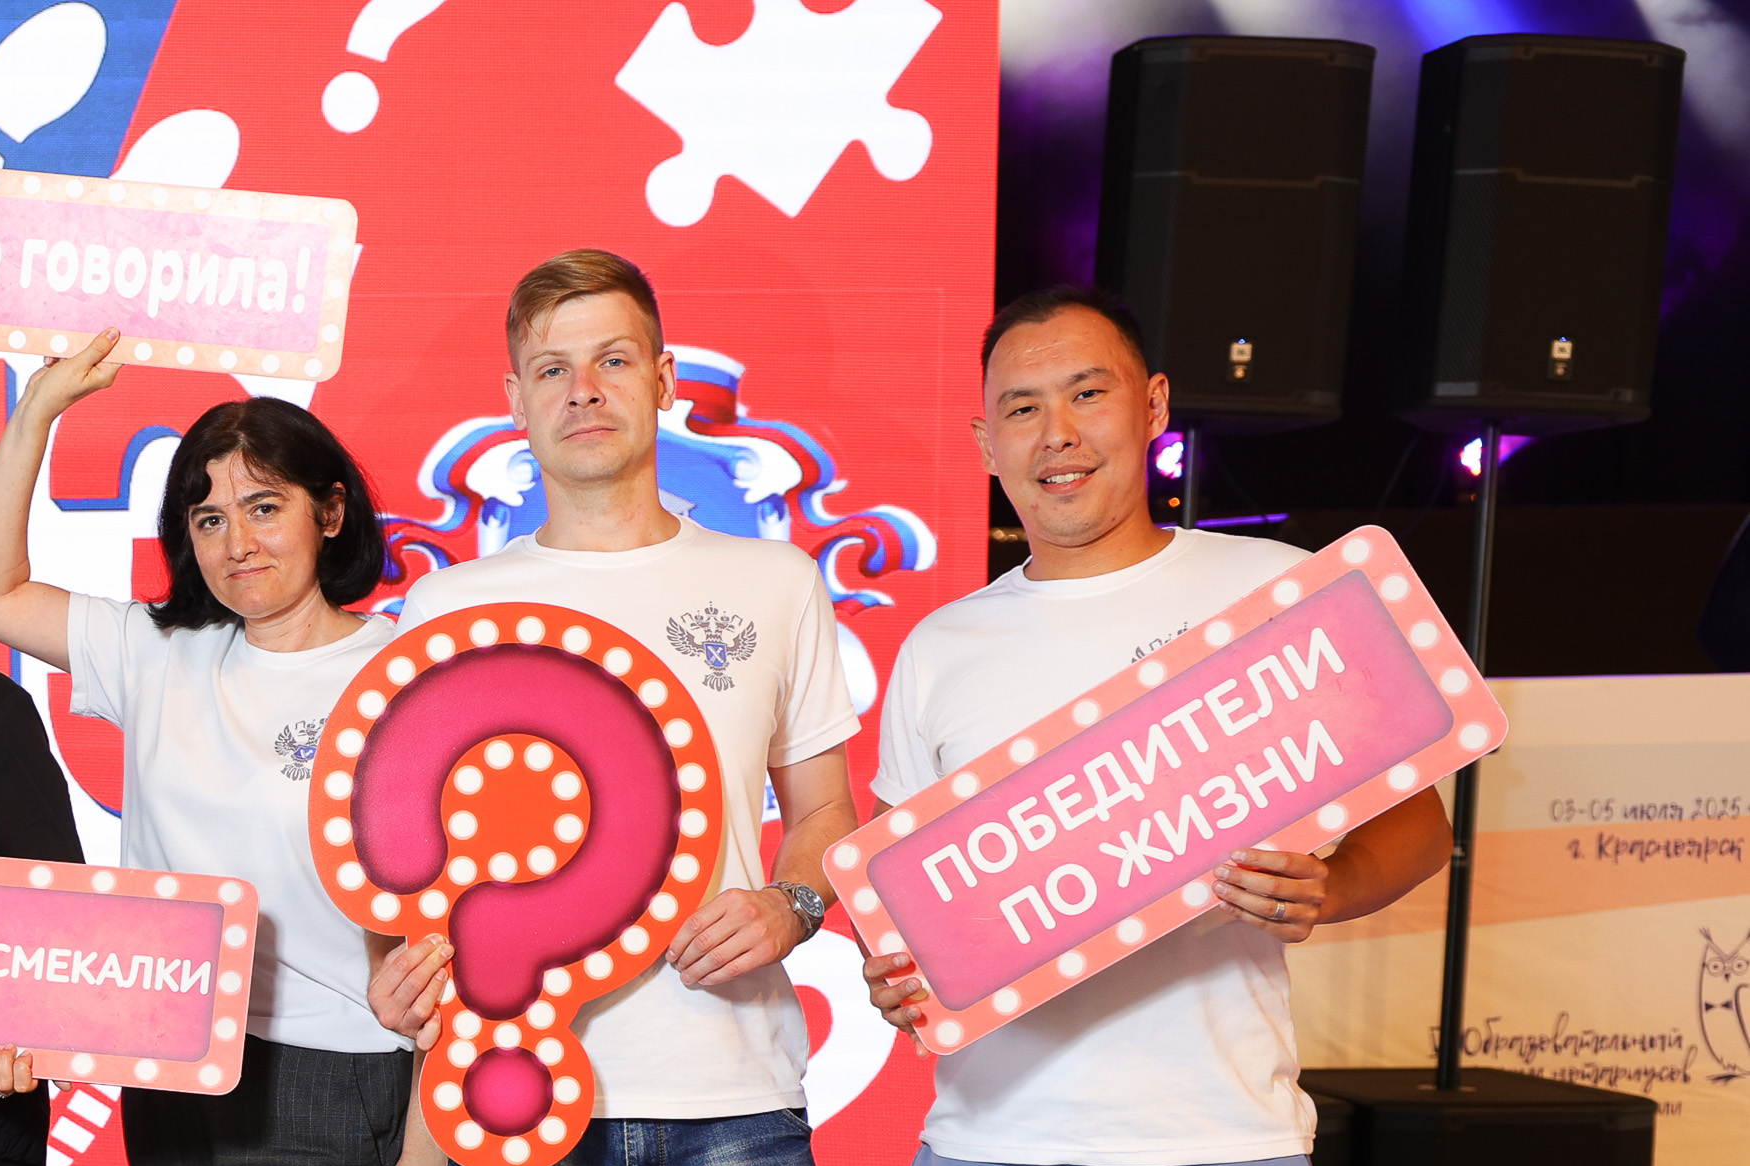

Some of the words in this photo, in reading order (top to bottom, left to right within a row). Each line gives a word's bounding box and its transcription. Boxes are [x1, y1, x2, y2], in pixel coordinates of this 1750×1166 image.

[19, 237, 312, 319] говорила!
[921, 627, 1347, 903] ПОБЕДИТЕЛИ
[999, 863, 1099, 945] ПО
[1098, 719, 1345, 888] ЖИЗНИ
[1551, 797, 1615, 823] 03-05
[1623, 802, 1684, 822] июля
[1691, 795, 1742, 821] 2025
[1596, 830, 1745, 866] Красноярск
